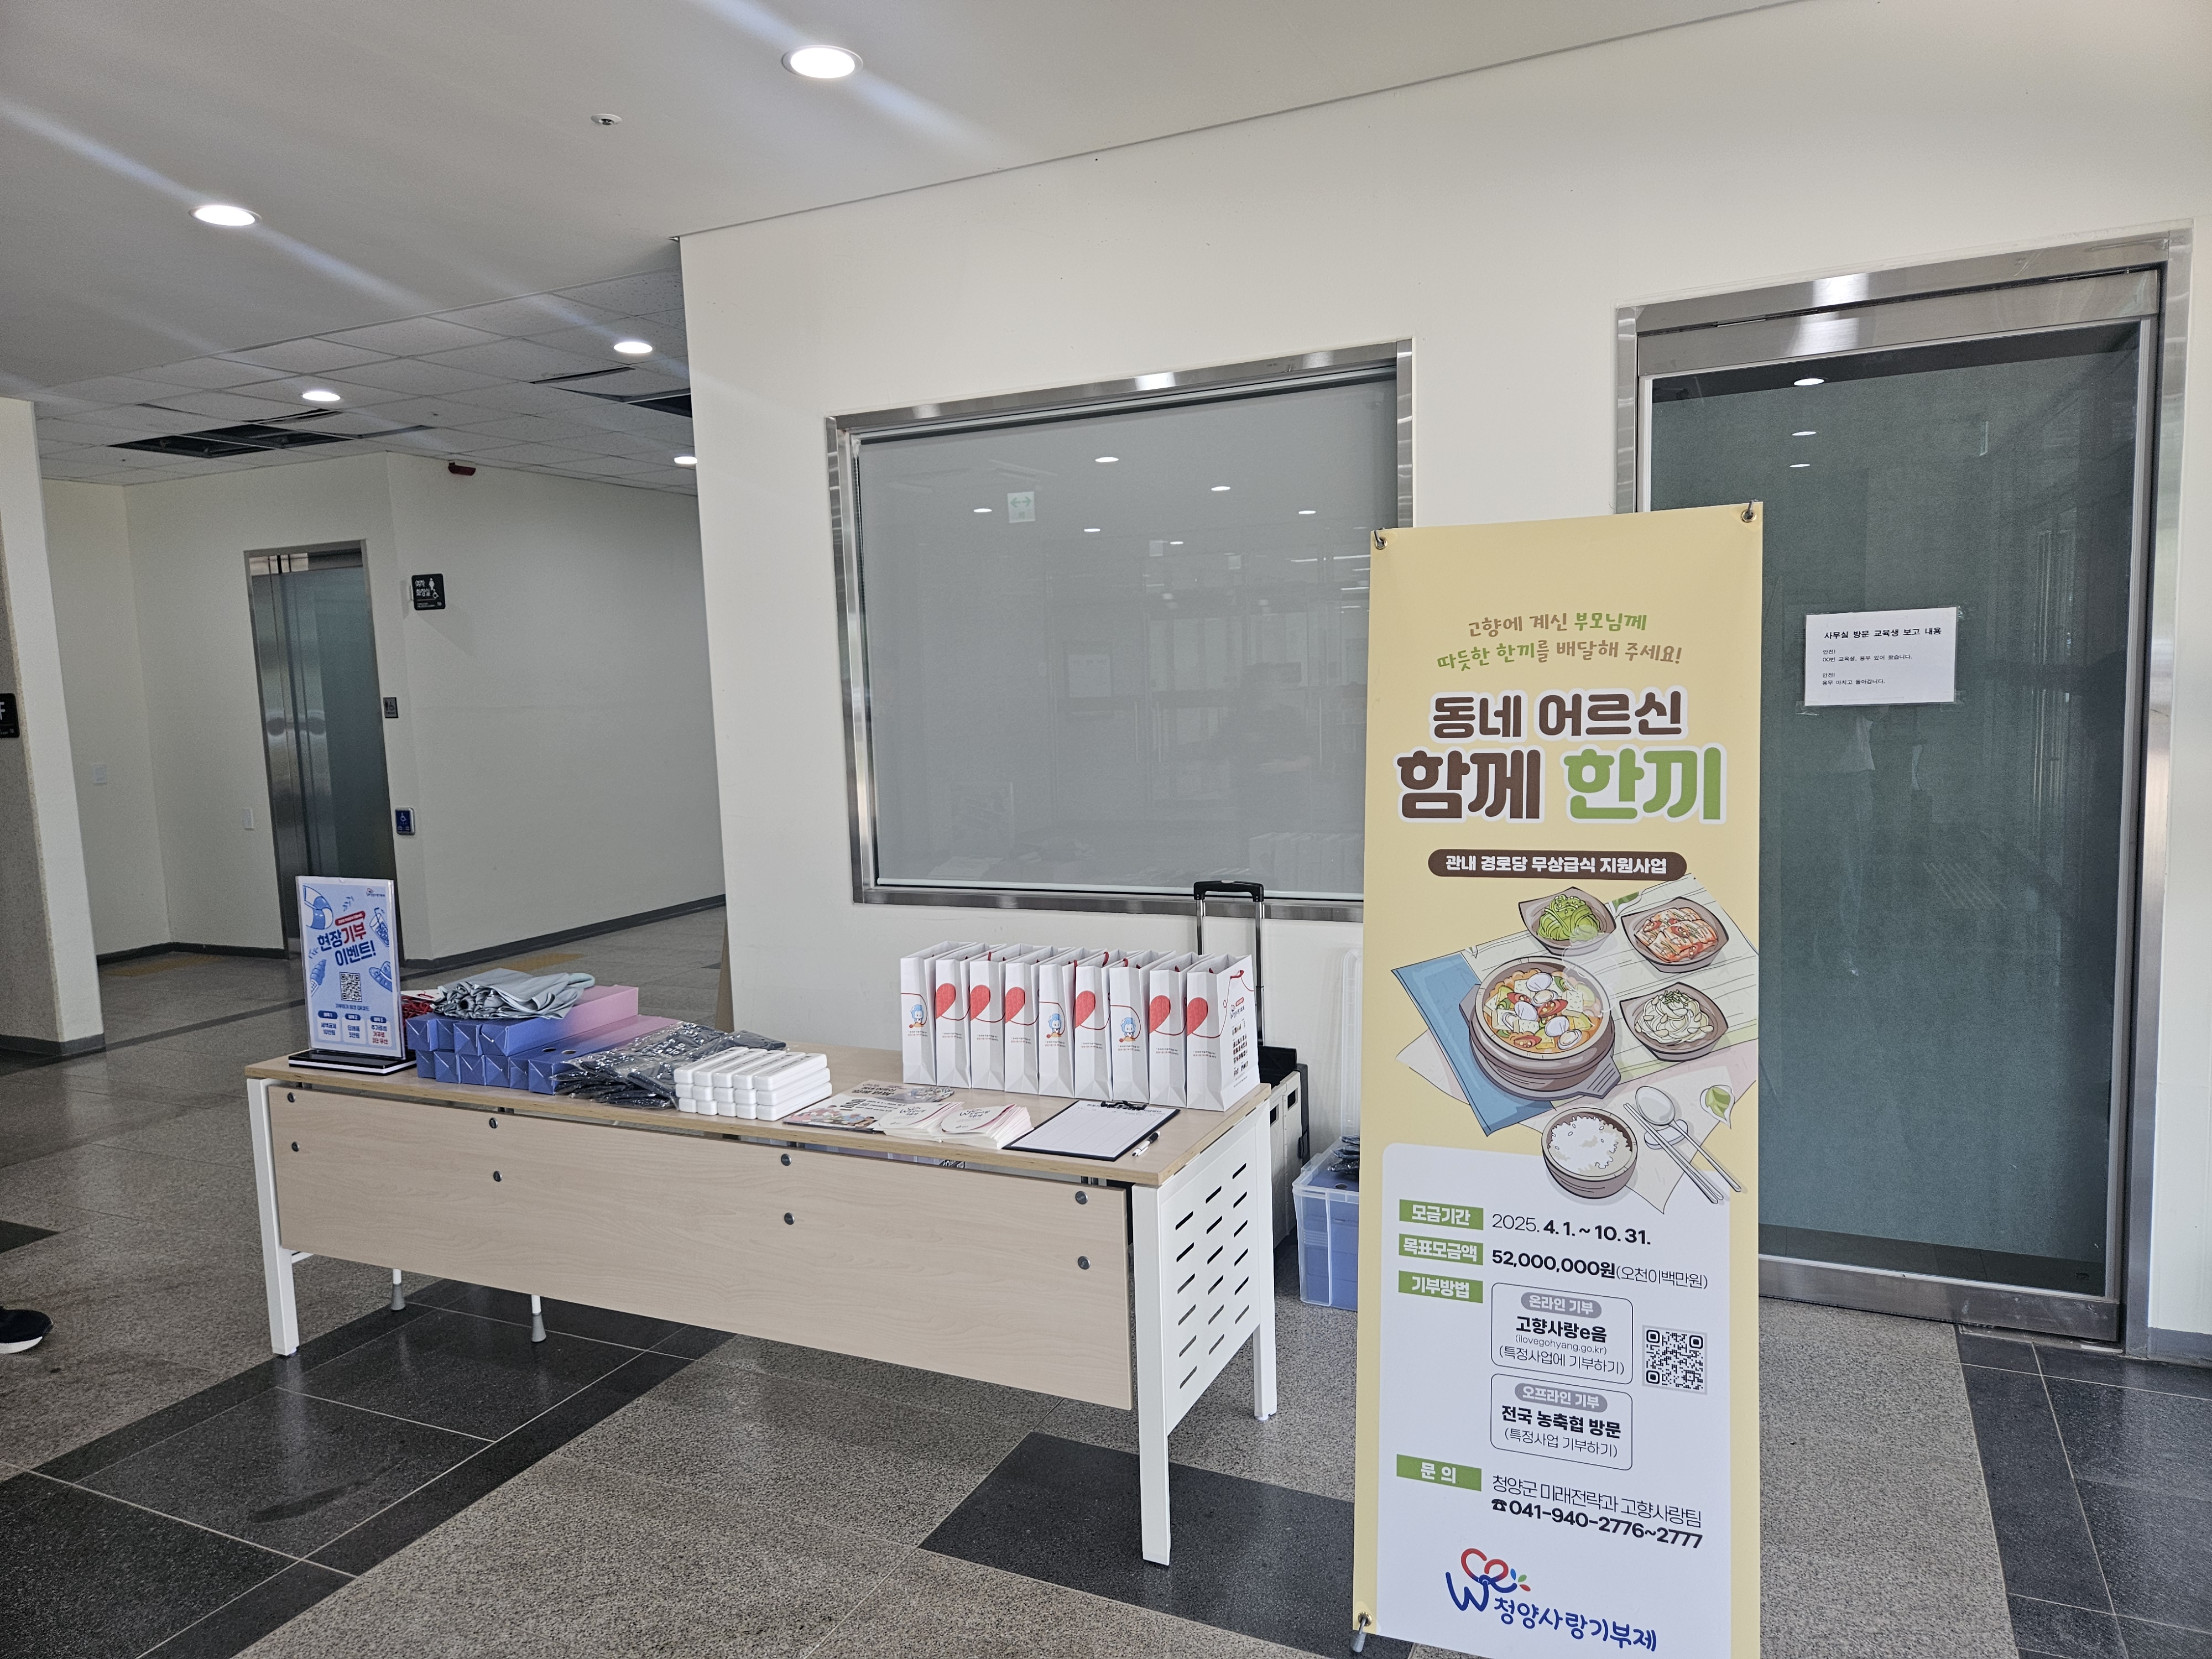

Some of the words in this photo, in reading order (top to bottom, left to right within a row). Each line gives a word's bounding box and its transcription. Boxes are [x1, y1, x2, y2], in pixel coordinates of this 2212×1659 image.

[1468, 616, 1522, 637] 고향에
[1530, 613, 1567, 632] 계신
[1575, 612, 1647, 632] 부모님께
[1438, 646, 1490, 671] 따듯한
[1496, 640, 1548, 663] 한끼를
[1557, 640, 1619, 661] 배달해
[1625, 642, 1682, 664] 주세요!
[1433, 695, 1522, 738] 동네
[1538, 691, 1682, 736] 어르신
[1397, 749, 1541, 819] 함께
[1564, 747, 1721, 820] 한끼
[1446, 855, 1477, 872] 관내
[1481, 856, 1528, 872] 경로당
[1532, 857, 1595, 873] 무상급식
[1600, 858, 1667, 874] 지원사업
[335, 940, 376, 966] 이벤트!
[1412, 1205, 1470, 1226] 모금기간
[1493, 1214, 1540, 1233] 2025.
[1403, 1238, 1477, 1262] 목표모금액
[1412, 1276, 1469, 1299] 기부방법
[1529, 1295, 1566, 1312] 온라인
[1569, 1298, 1593, 1315] 기부
[1516, 1316, 1607, 1343] 고향사랑e음
[1515, 1333, 1608, 1355] (ilovegohyang.go.kr)
[1499, 1344, 1566, 1368] (특정사업에
[1569, 1354, 1625, 1376] 기부하기)
[1522, 1385, 1571, 1405] 오프라인
[1574, 1392, 1599, 1409] 기부
[1502, 1405, 1532, 1426] 전국
[1537, 1410, 1584, 1433] 농축협
[1589, 1418, 1621, 1439] 방문
[1504, 1427, 1559, 1449] (특정사업
[1563, 1436, 1618, 1458] 기부하기)
[1493, 1475, 1538, 1497] 청양군
[1540, 1483, 1618, 1513] 미래전략과
[1621, 1496, 1702, 1528] 고향사랑팀
[1494, 1597, 1657, 1652] 청양사랑기부제
